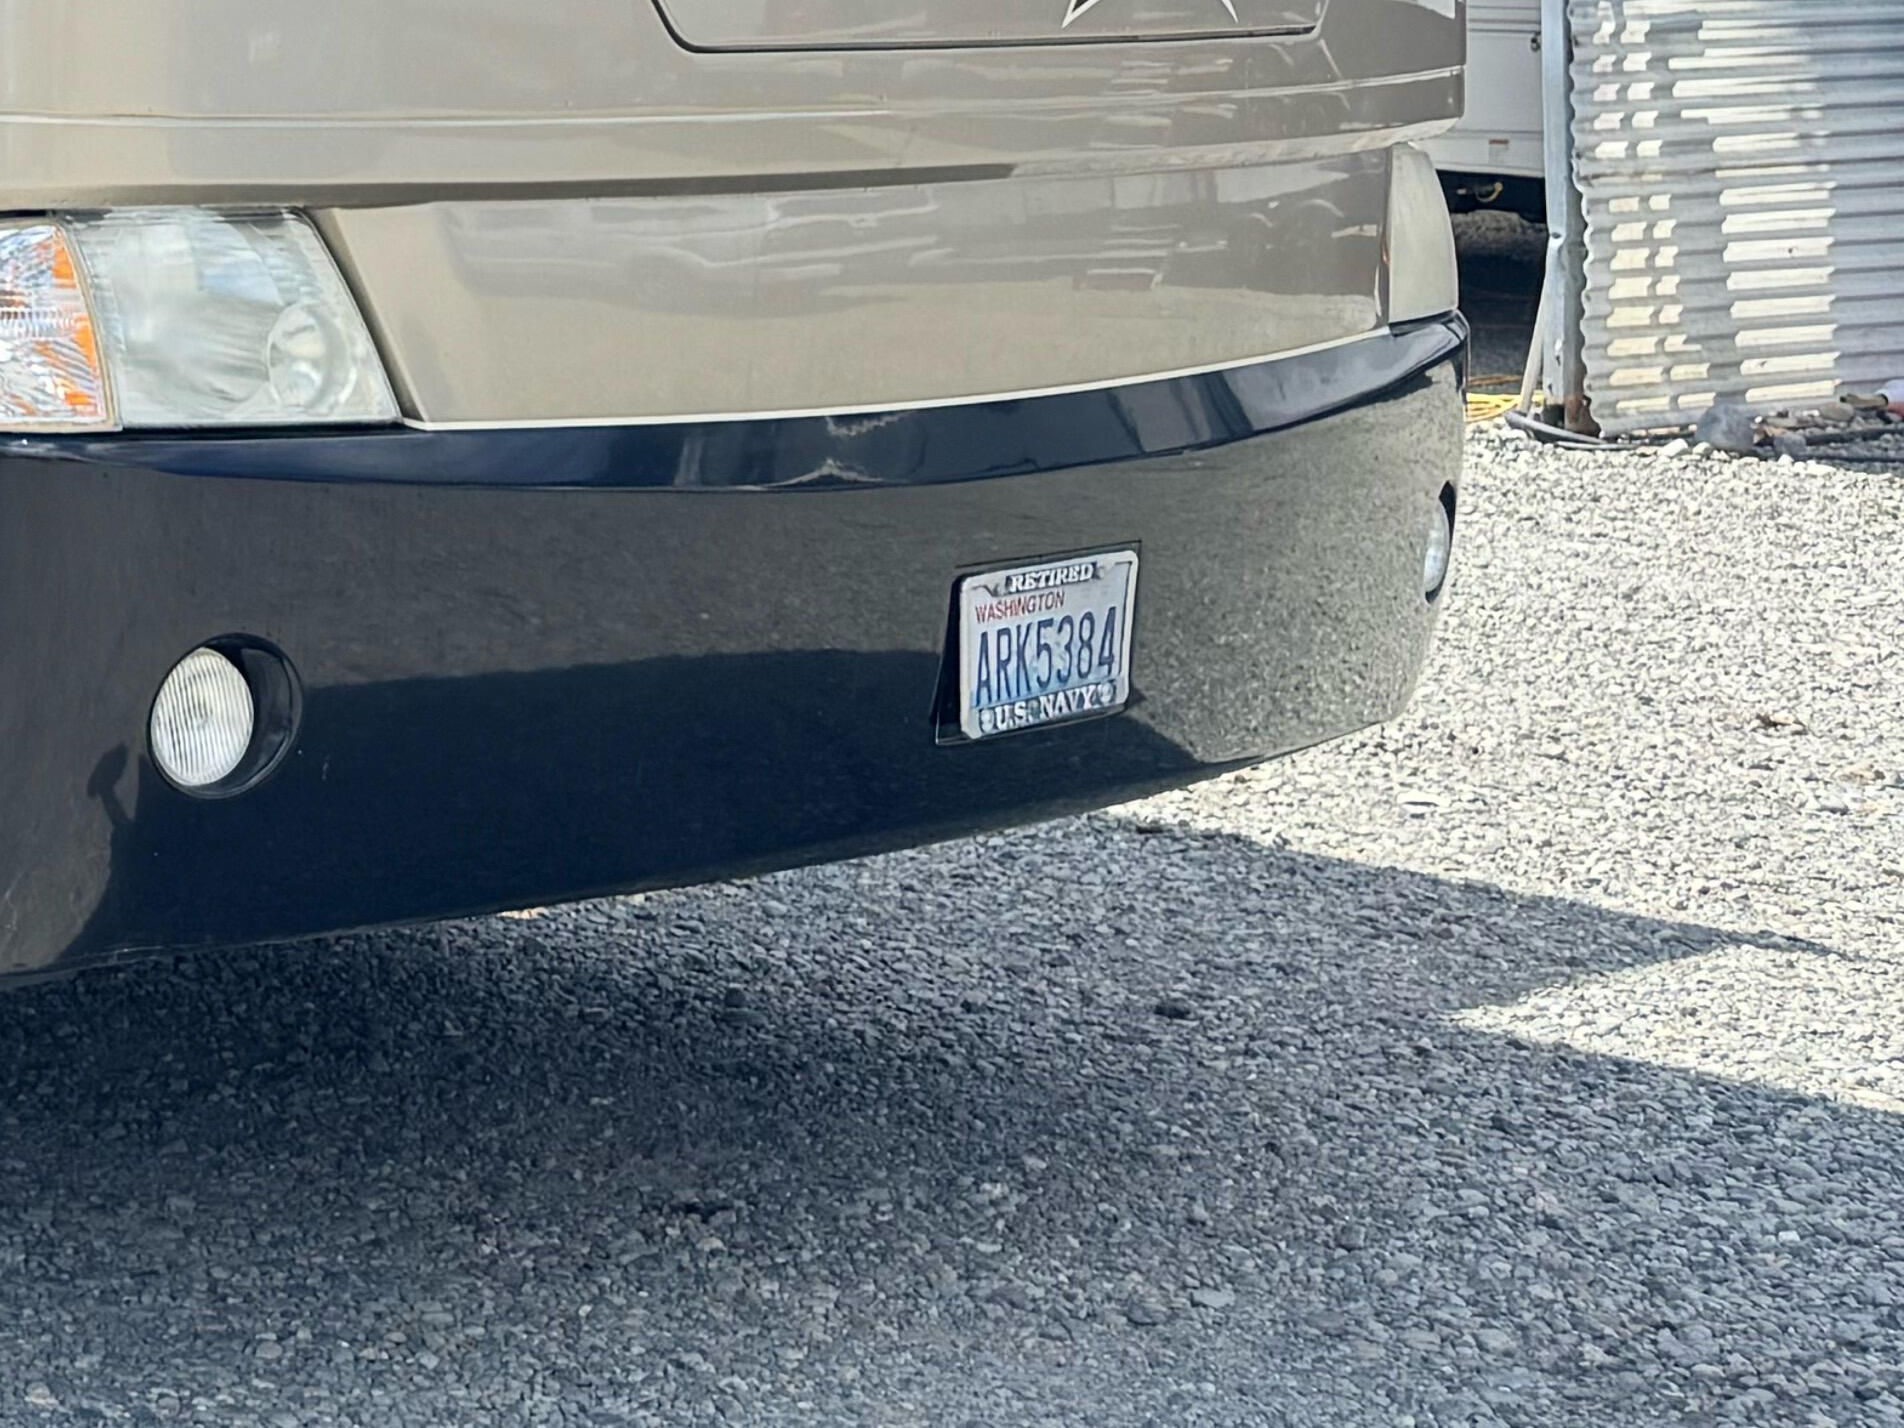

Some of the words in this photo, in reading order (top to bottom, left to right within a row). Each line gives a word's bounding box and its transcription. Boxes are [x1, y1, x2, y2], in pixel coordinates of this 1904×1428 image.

[1009, 563, 1094, 593] RETIRED
[974, 590, 1066, 624] WASHINGTON
[975, 606, 1117, 706] ARK5384
[1040, 684, 1097, 719] NAVY
